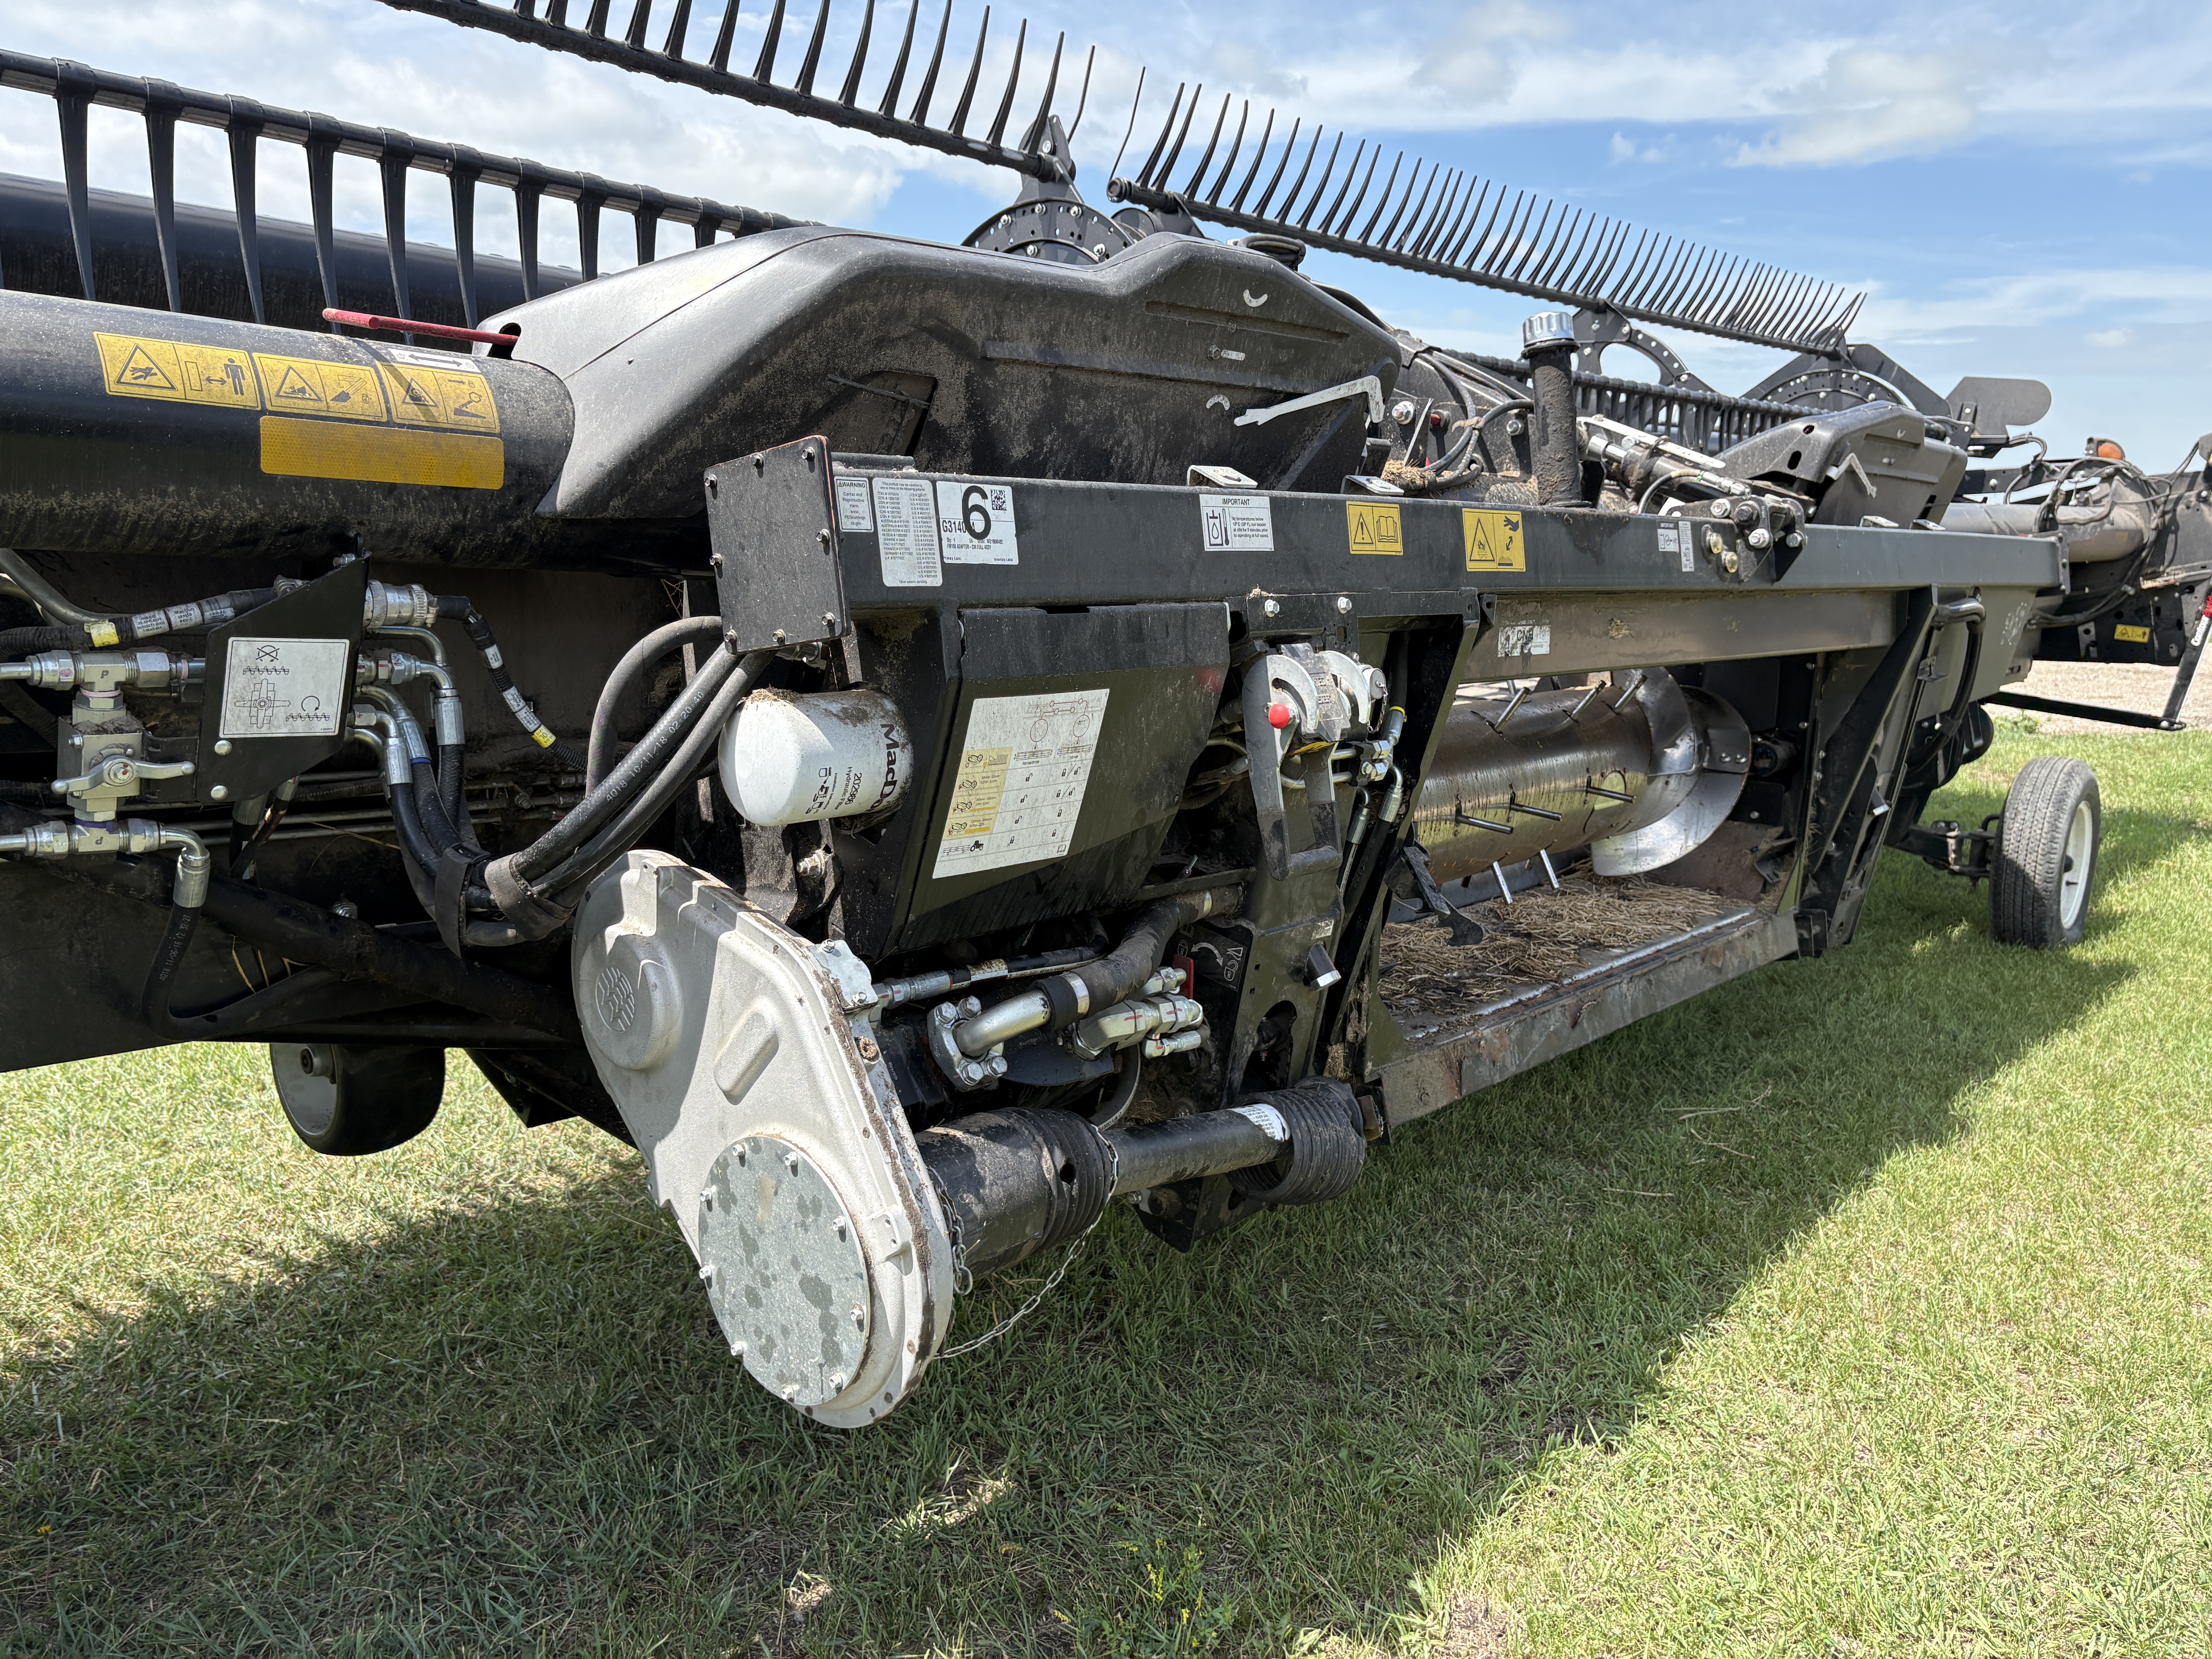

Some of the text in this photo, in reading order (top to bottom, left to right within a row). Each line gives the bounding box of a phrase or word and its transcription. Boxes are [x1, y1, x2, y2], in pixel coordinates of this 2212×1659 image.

[962, 485, 991, 540] 6
[629, 736, 668, 777] 10/11/18
[669, 692, 704, 734] 02:20:40
[842, 767, 853, 797] Hydraulic
[845, 773, 862, 805] 202986
[888, 1061, 898, 1080] Rexroth
